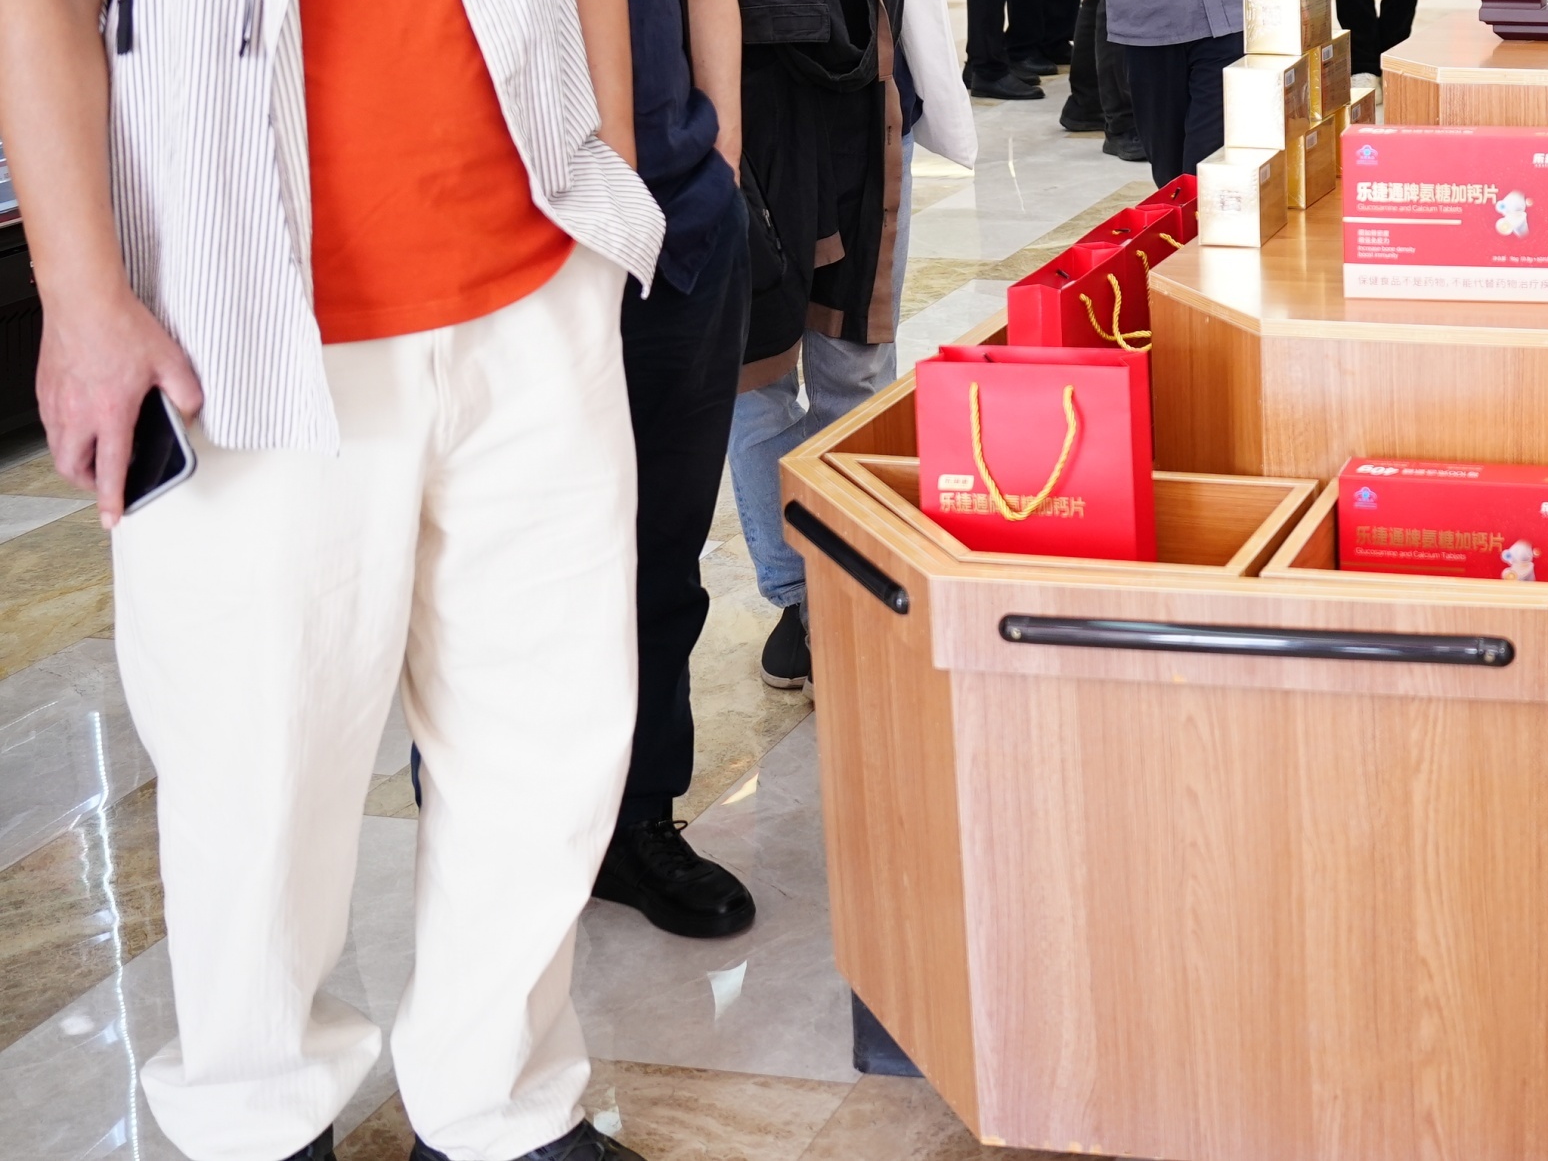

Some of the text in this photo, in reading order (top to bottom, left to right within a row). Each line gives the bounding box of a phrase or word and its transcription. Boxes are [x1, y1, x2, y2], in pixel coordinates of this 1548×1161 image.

[1356, 181, 1498, 204] 乐捷通牌氨糖加钙片
[1357, 204, 1463, 214] Glucosamine and Calcium Tablets
[1355, 526, 1505, 553] 乐捷通牌氨糖加钙片
[1355, 547, 1466, 561] Glucosamine and Calcium Tablets
